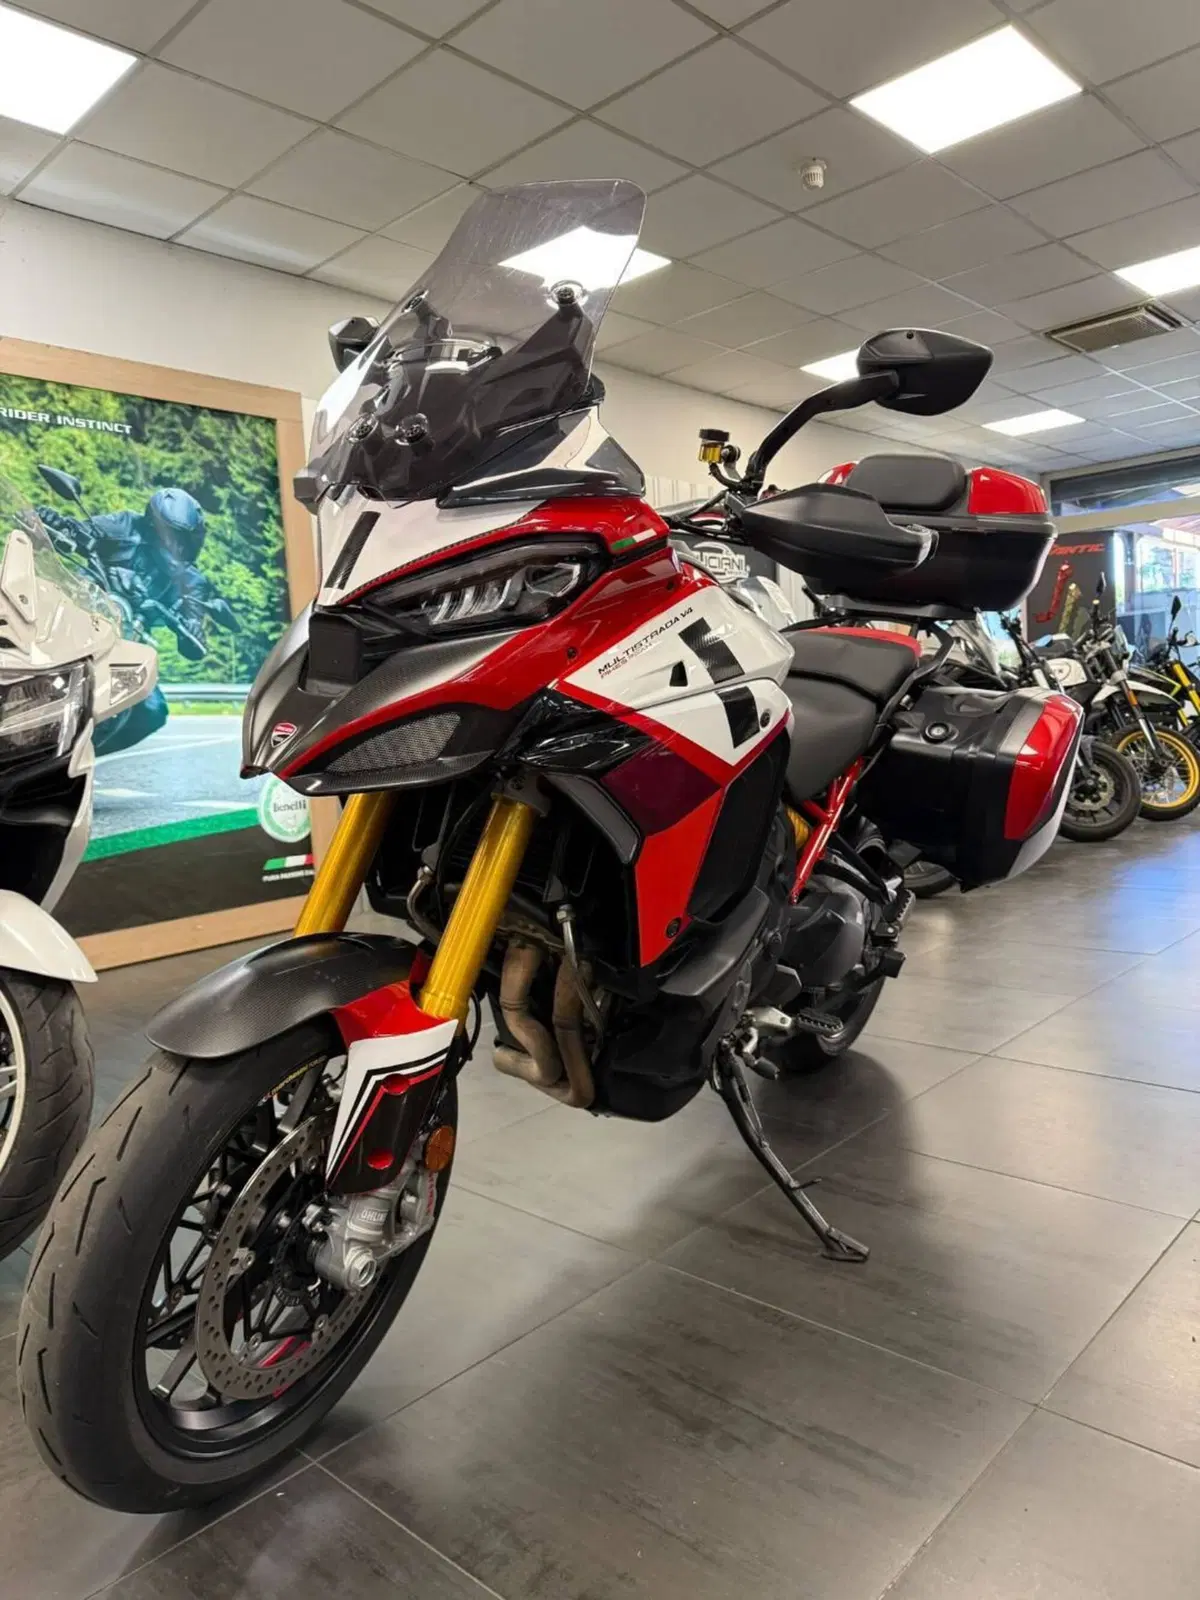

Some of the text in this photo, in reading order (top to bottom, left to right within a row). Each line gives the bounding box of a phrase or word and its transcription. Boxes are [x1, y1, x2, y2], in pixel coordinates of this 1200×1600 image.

[0, 407, 132, 434] RIDER INSTINCT
[1050, 543, 1105, 556] ANTIC
[598, 606, 694, 675] MULTISTRADA V4
